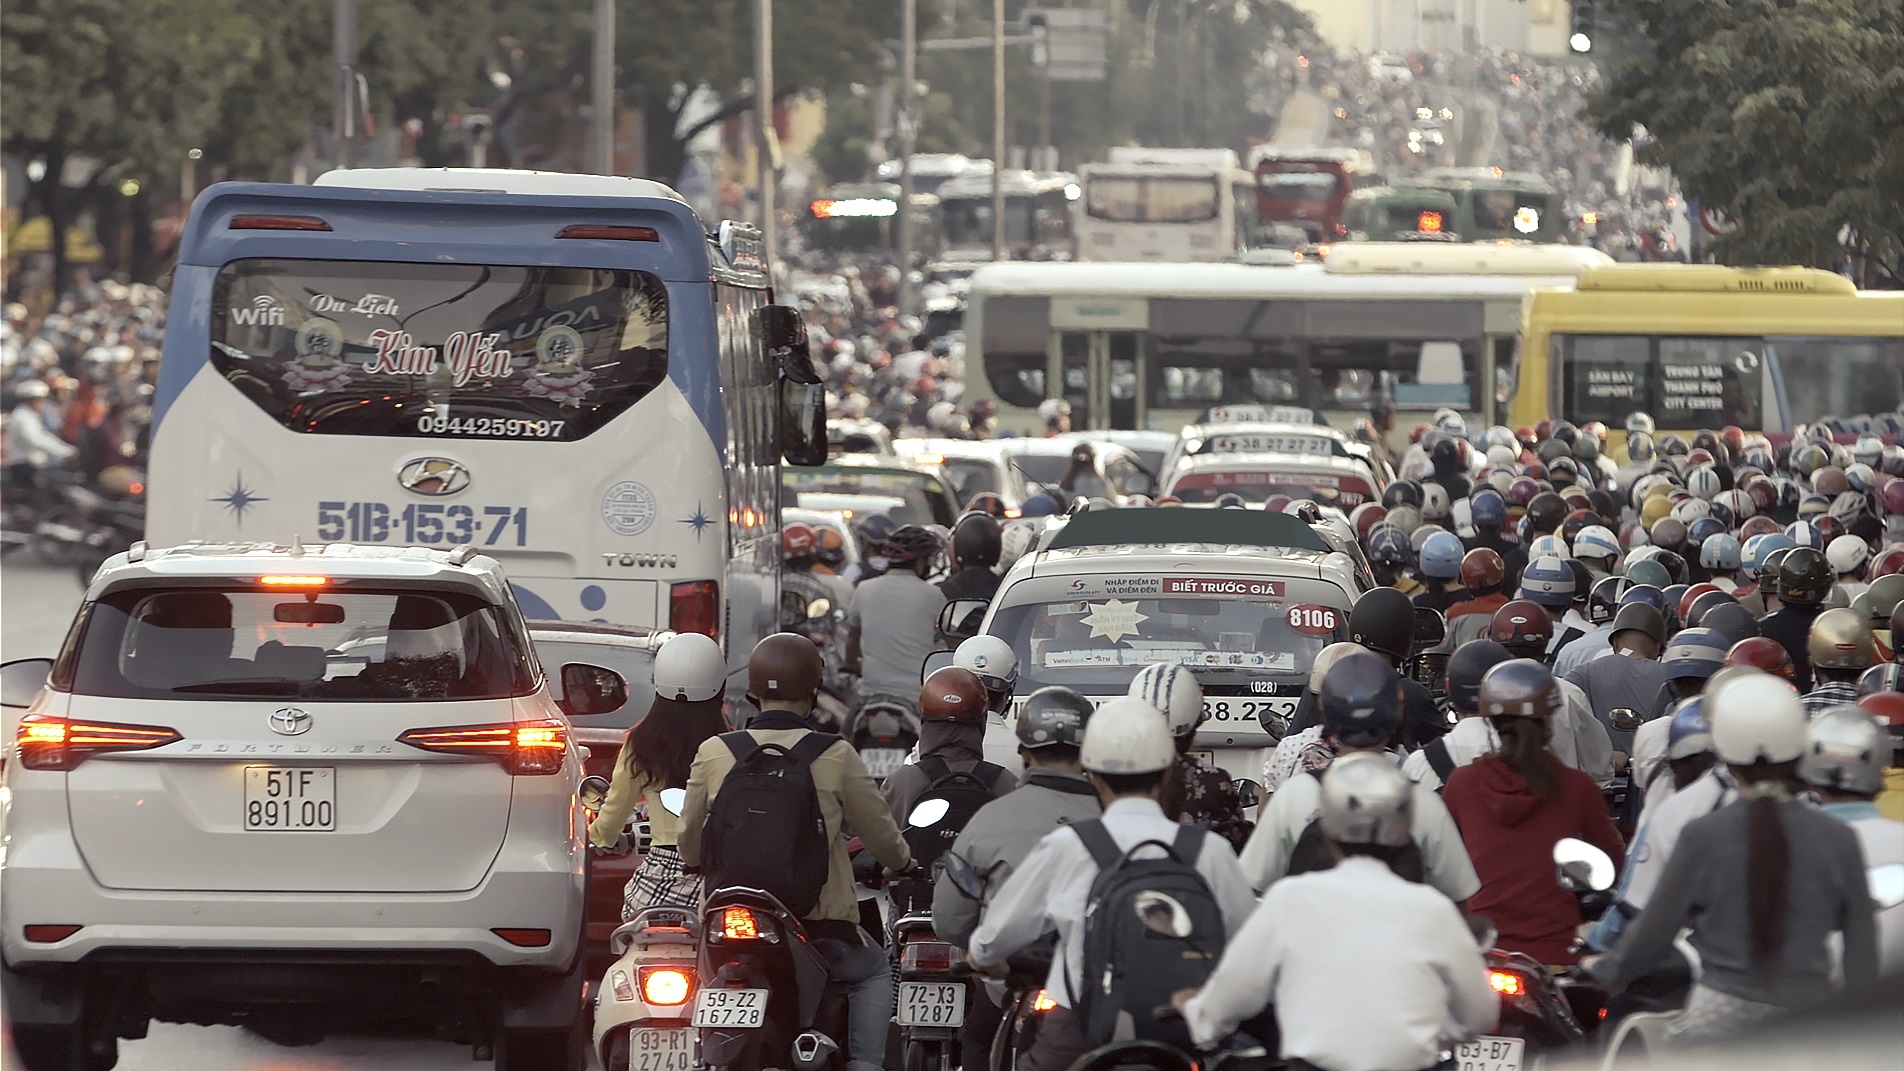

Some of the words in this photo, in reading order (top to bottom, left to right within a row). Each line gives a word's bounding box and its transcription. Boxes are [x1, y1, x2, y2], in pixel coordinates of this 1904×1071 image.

[309, 294, 345, 313] Du
[231, 307, 284, 326] Wifi
[363, 329, 439, 376] Kim
[417, 416, 565, 438] 0944259197
[602, 553, 677, 568] TOWN
[1171, 579, 1198, 592] BIẾT
[1200, 581, 1247, 593] TRƯỚC
[1250, 583, 1276, 595] GIÁ
[1290, 608, 1335, 629] 8106
[1250, 681, 1278, 693] (028)
[187, 743, 392, 754] FORTUNER
[267, 770, 314, 798] 51F
[248, 800, 332, 827] 891.00
[706, 992, 757, 1008] 59-Z2
[908, 985, 955, 1004] 72-X3
[698, 1009, 760, 1024] 167.28
[908, 1004, 955, 1023] 1287
[640, 1031, 687, 1050] 93-R1
[640, 1052, 688, 1071] 2740
